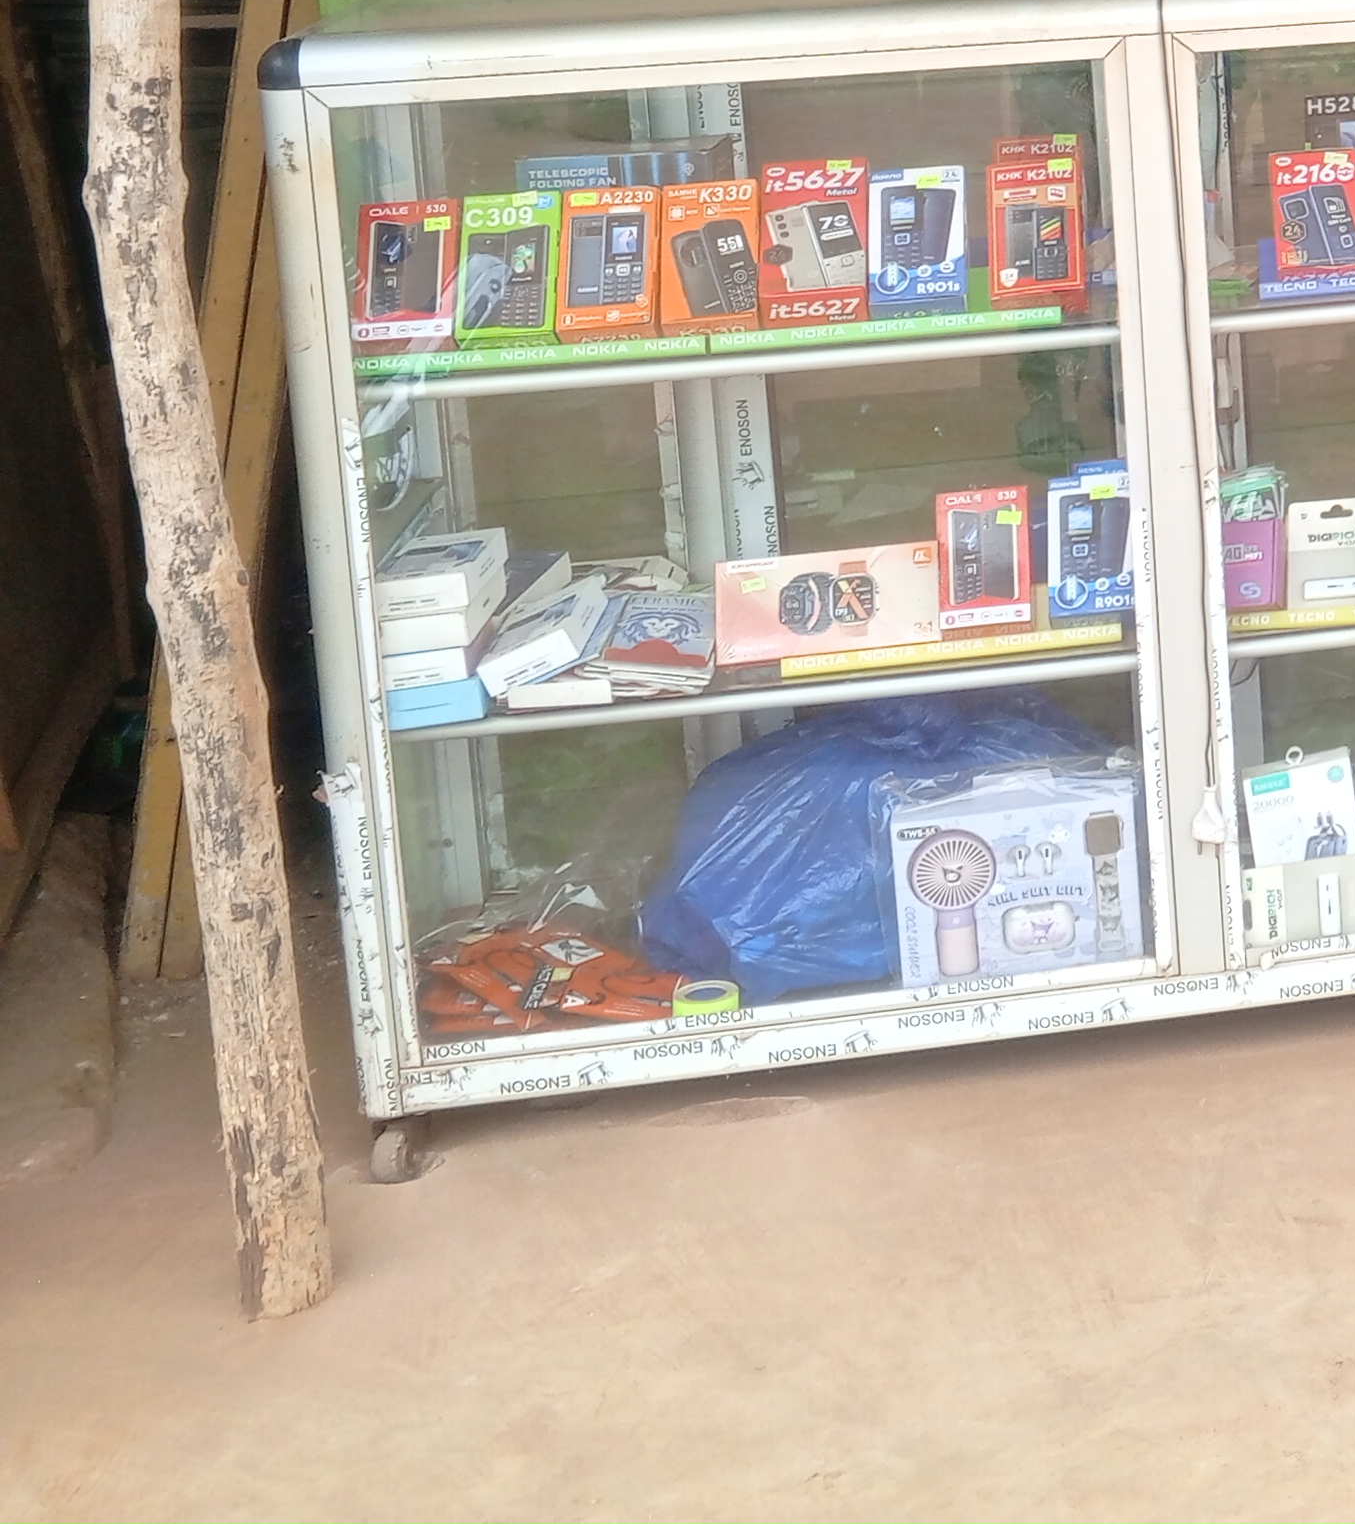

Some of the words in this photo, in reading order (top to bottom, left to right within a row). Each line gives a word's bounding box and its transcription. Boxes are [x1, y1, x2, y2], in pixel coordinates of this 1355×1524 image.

[527, 166, 609, 179] TELESCOPIC
[528, 178, 581, 189] FOLDING
[586, 176, 618, 188] FAN
[764, 166, 868, 195] it5627
[600, 190, 654, 206] A2230
[699, 183, 753, 203] K330
[825, 186, 858, 198] Metal
[425, 203, 448, 215] 530
[465, 206, 535, 228] C309
[1264, 280, 1317, 293] TECNO
[769, 297, 861, 320] it5627
[500, 347, 557, 362] NOKIA
[643, 337, 701, 352] NOKIA
[790, 326, 847, 340] NOKIA
[931, 313, 986, 327] NOKIA
[734, 397, 749, 457] ENOSON
[1288, 610, 1336, 623] TECNO
[788, 653, 849, 670] NOKIA
[995, 631, 1053, 647] NOKIA
[1152, 974, 1219, 997] ENOSON
[684, 1007, 754, 1028] ENOSON
[897, 1008, 965, 1029] ENOSON
[767, 1044, 836, 1064] ENOSON
[500, 1074, 571, 1095] ENOSON
